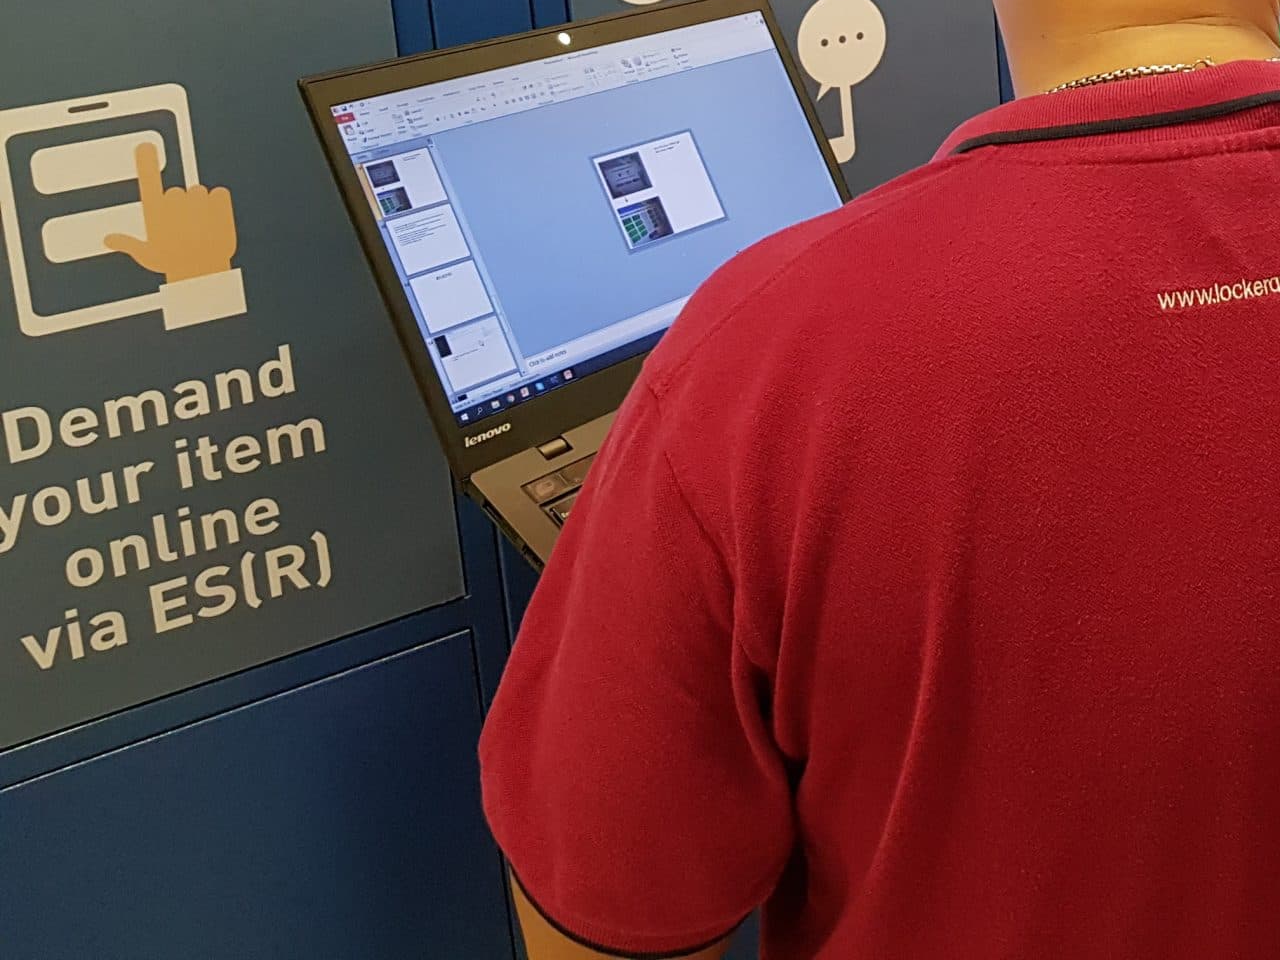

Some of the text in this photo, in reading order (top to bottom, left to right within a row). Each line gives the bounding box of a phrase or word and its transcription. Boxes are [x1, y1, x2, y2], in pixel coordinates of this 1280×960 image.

[2, 343, 297, 464] Demand
[464, 422, 511, 448] lenovo
[0, 417, 327, 553] your item
[65, 497, 281, 587] online
[20, 530, 333, 670] via ES(R)
